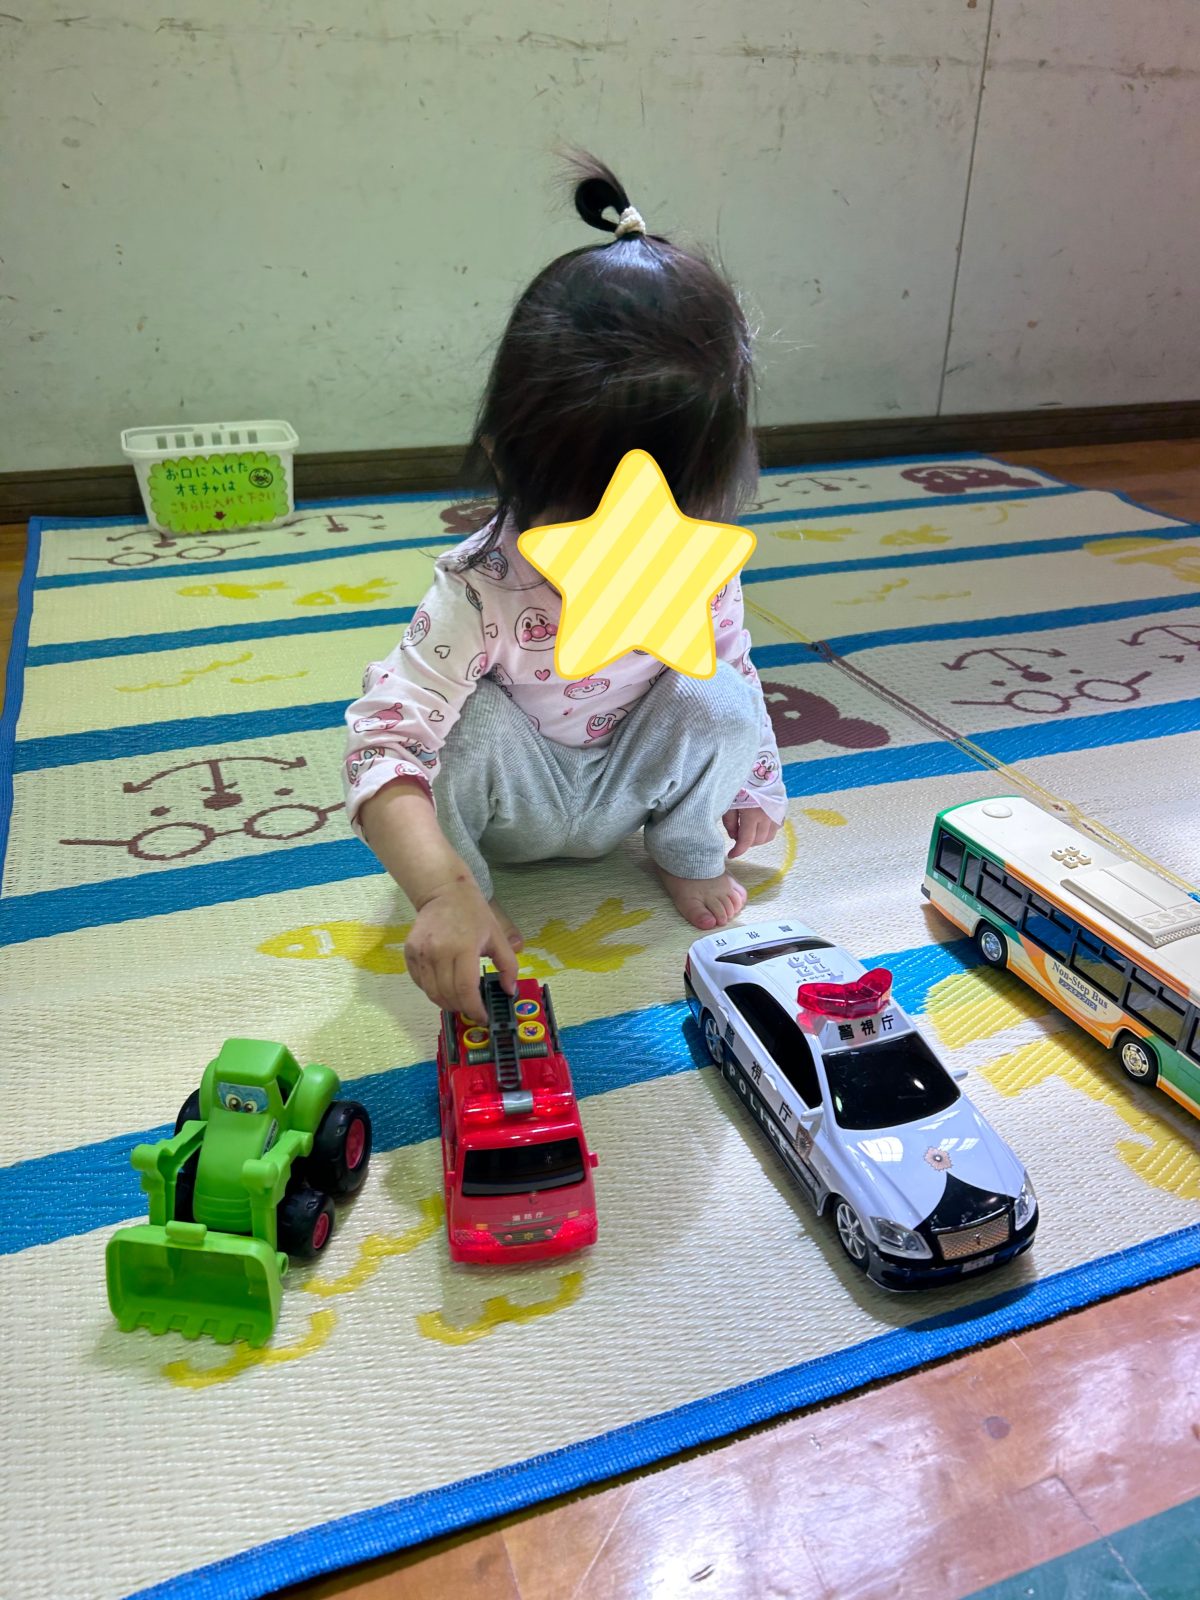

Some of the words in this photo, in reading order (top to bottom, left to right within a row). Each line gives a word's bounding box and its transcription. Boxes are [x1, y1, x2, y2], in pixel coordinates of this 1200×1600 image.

[166, 462, 248, 481] お口に入れた
[175, 481, 235, 497] オモチャは
[170, 491, 276, 514] こちらに入れて下さい
[1052, 961, 1091, 997] Non-Step
[1091, 991, 1108, 1009] Bus
[837, 1015, 895, 1041] 警視庁
[728, 1063, 788, 1154] POLICE
